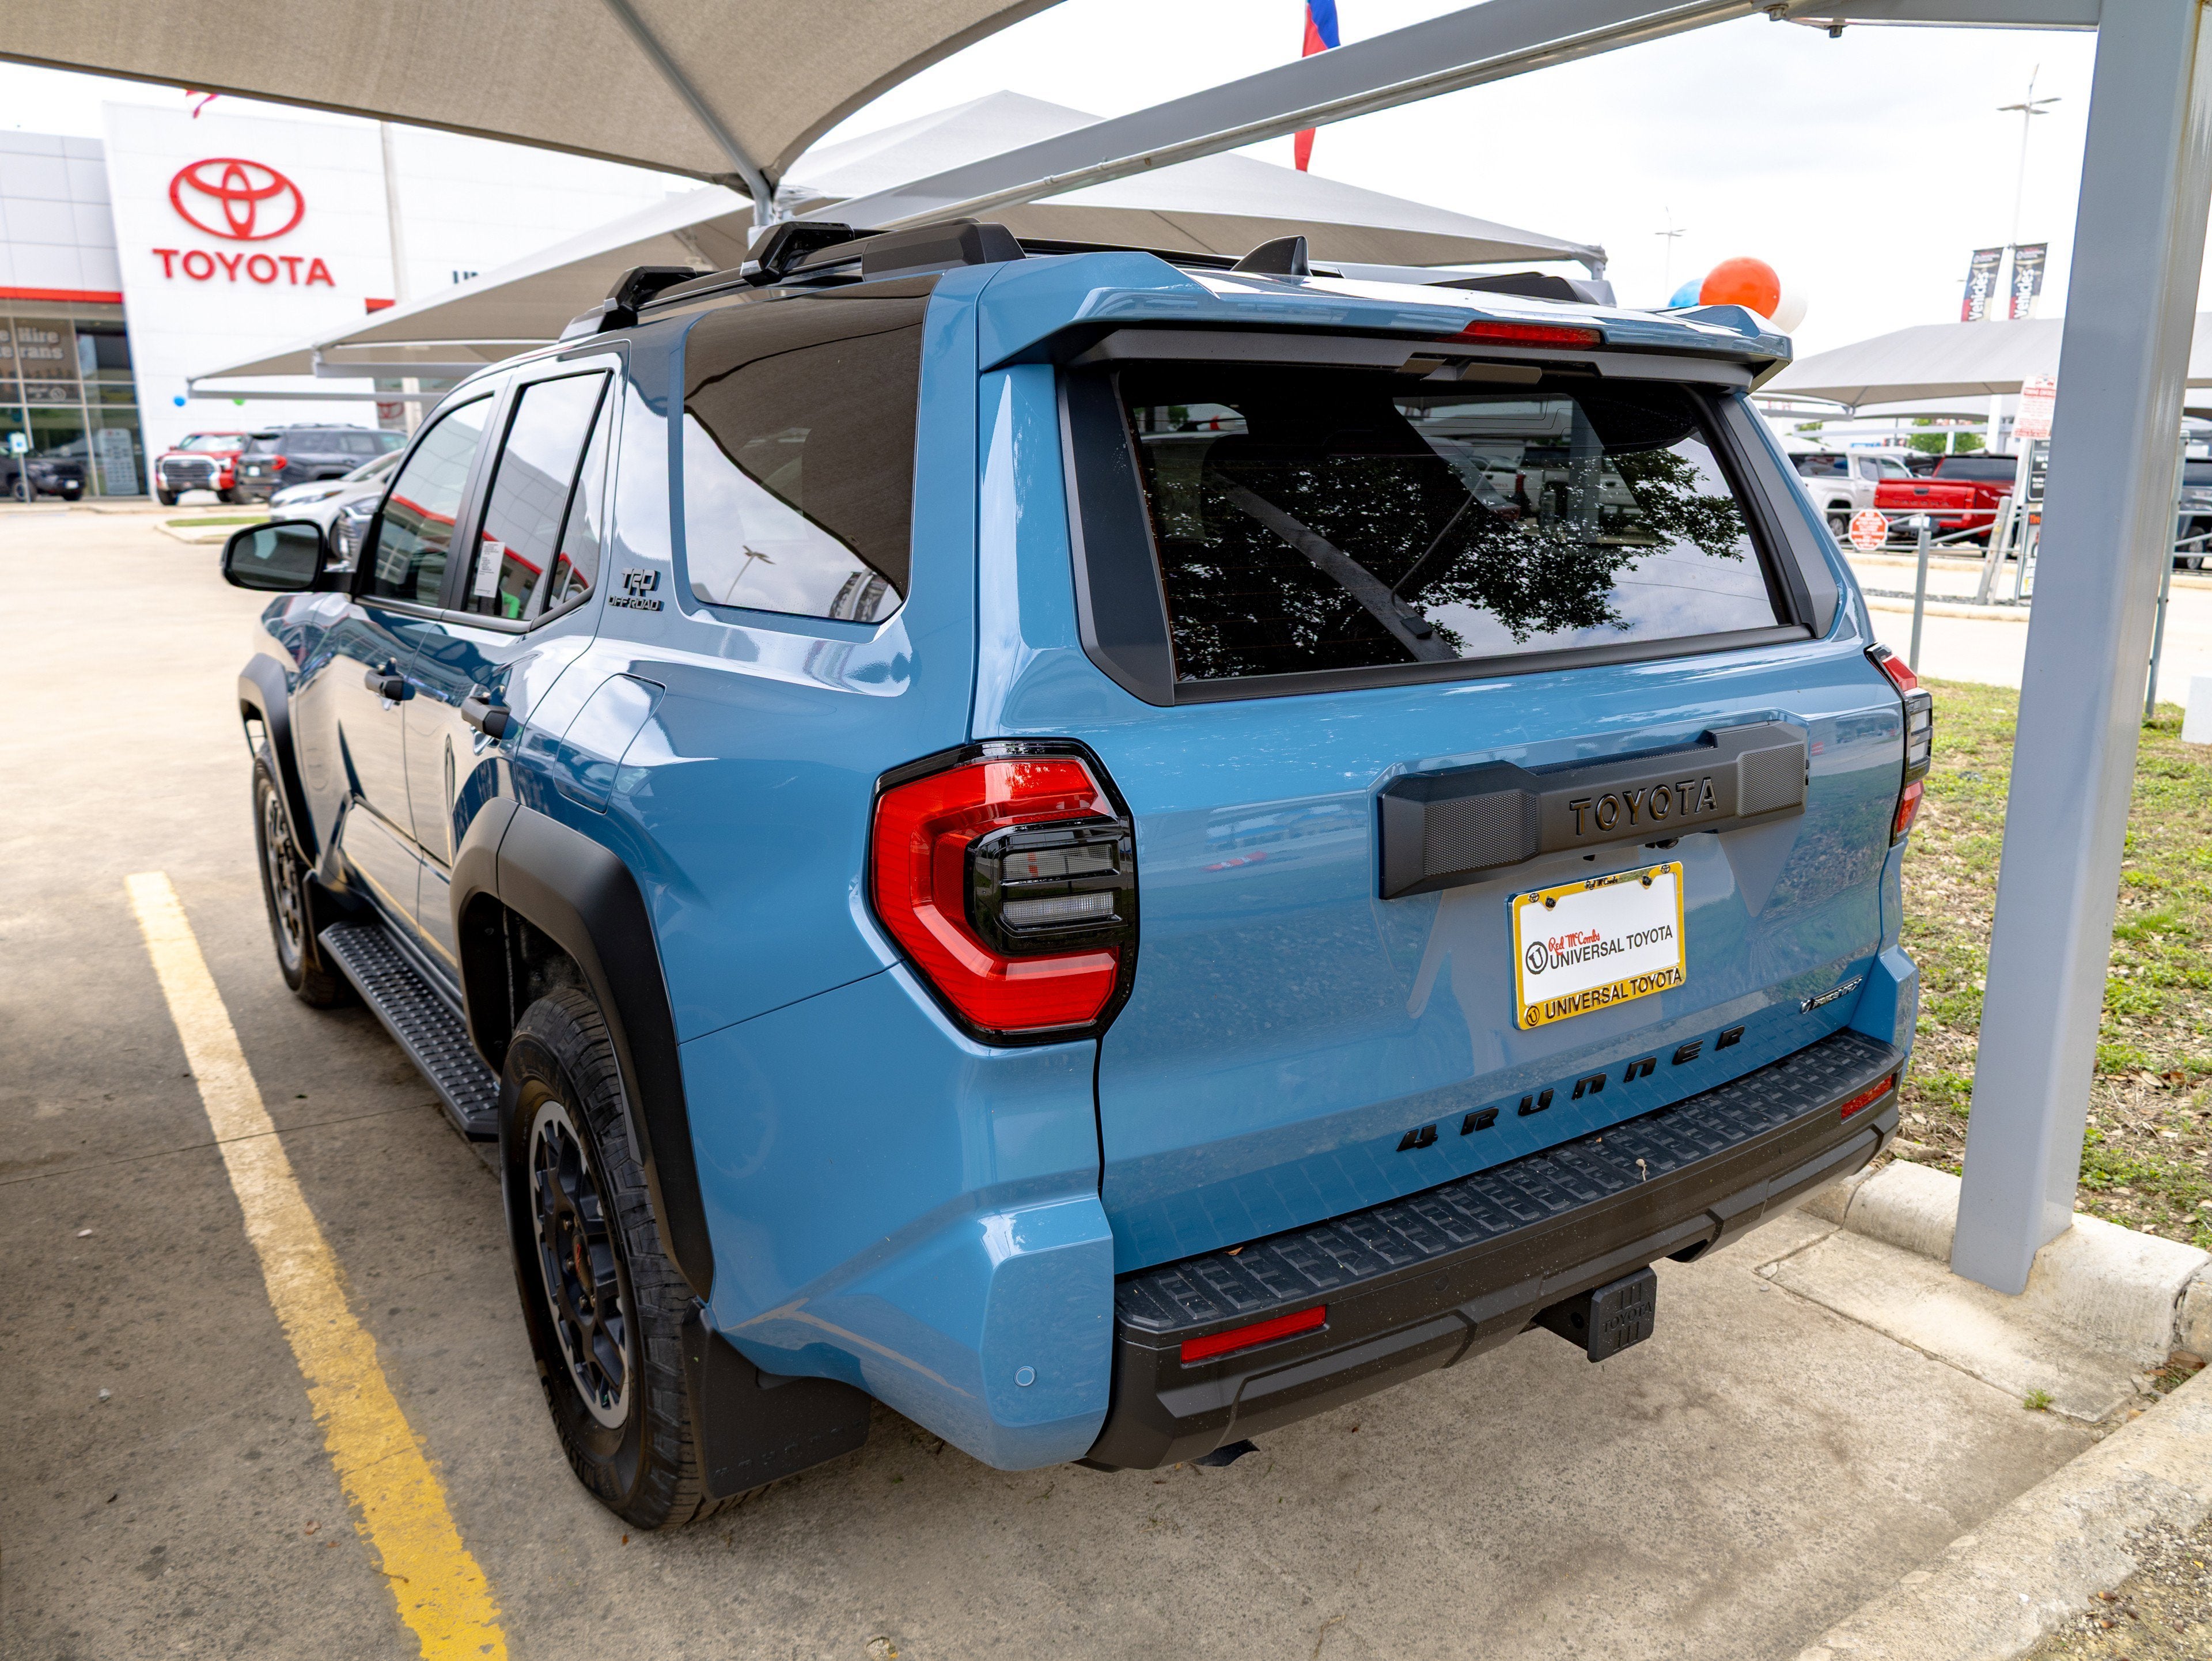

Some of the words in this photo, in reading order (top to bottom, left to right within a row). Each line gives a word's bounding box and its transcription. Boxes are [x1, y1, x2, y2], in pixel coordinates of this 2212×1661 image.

[152, 249, 336, 287] TOYOTA
[1968, 271, 1989, 320] Vehicles
[2014, 268, 2035, 318] Vehicles
[622, 567, 660, 597] TRD
[1570, 776, 1718, 836] TOYOTA
[1548, 936, 1565, 956] Red
[1565, 929, 1601, 947] McCombs
[1550, 937, 1625, 970] UNIVERSAL
[1626, 924, 1673, 950] TOYOTA
[1544, 982, 1628, 1019] UNIVERSAL
[1628, 966, 1682, 996] TOYOTA
[1396, 1024, 1745, 1152] 4RUNNER
[1603, 1301, 1653, 1333] TOYOTA
